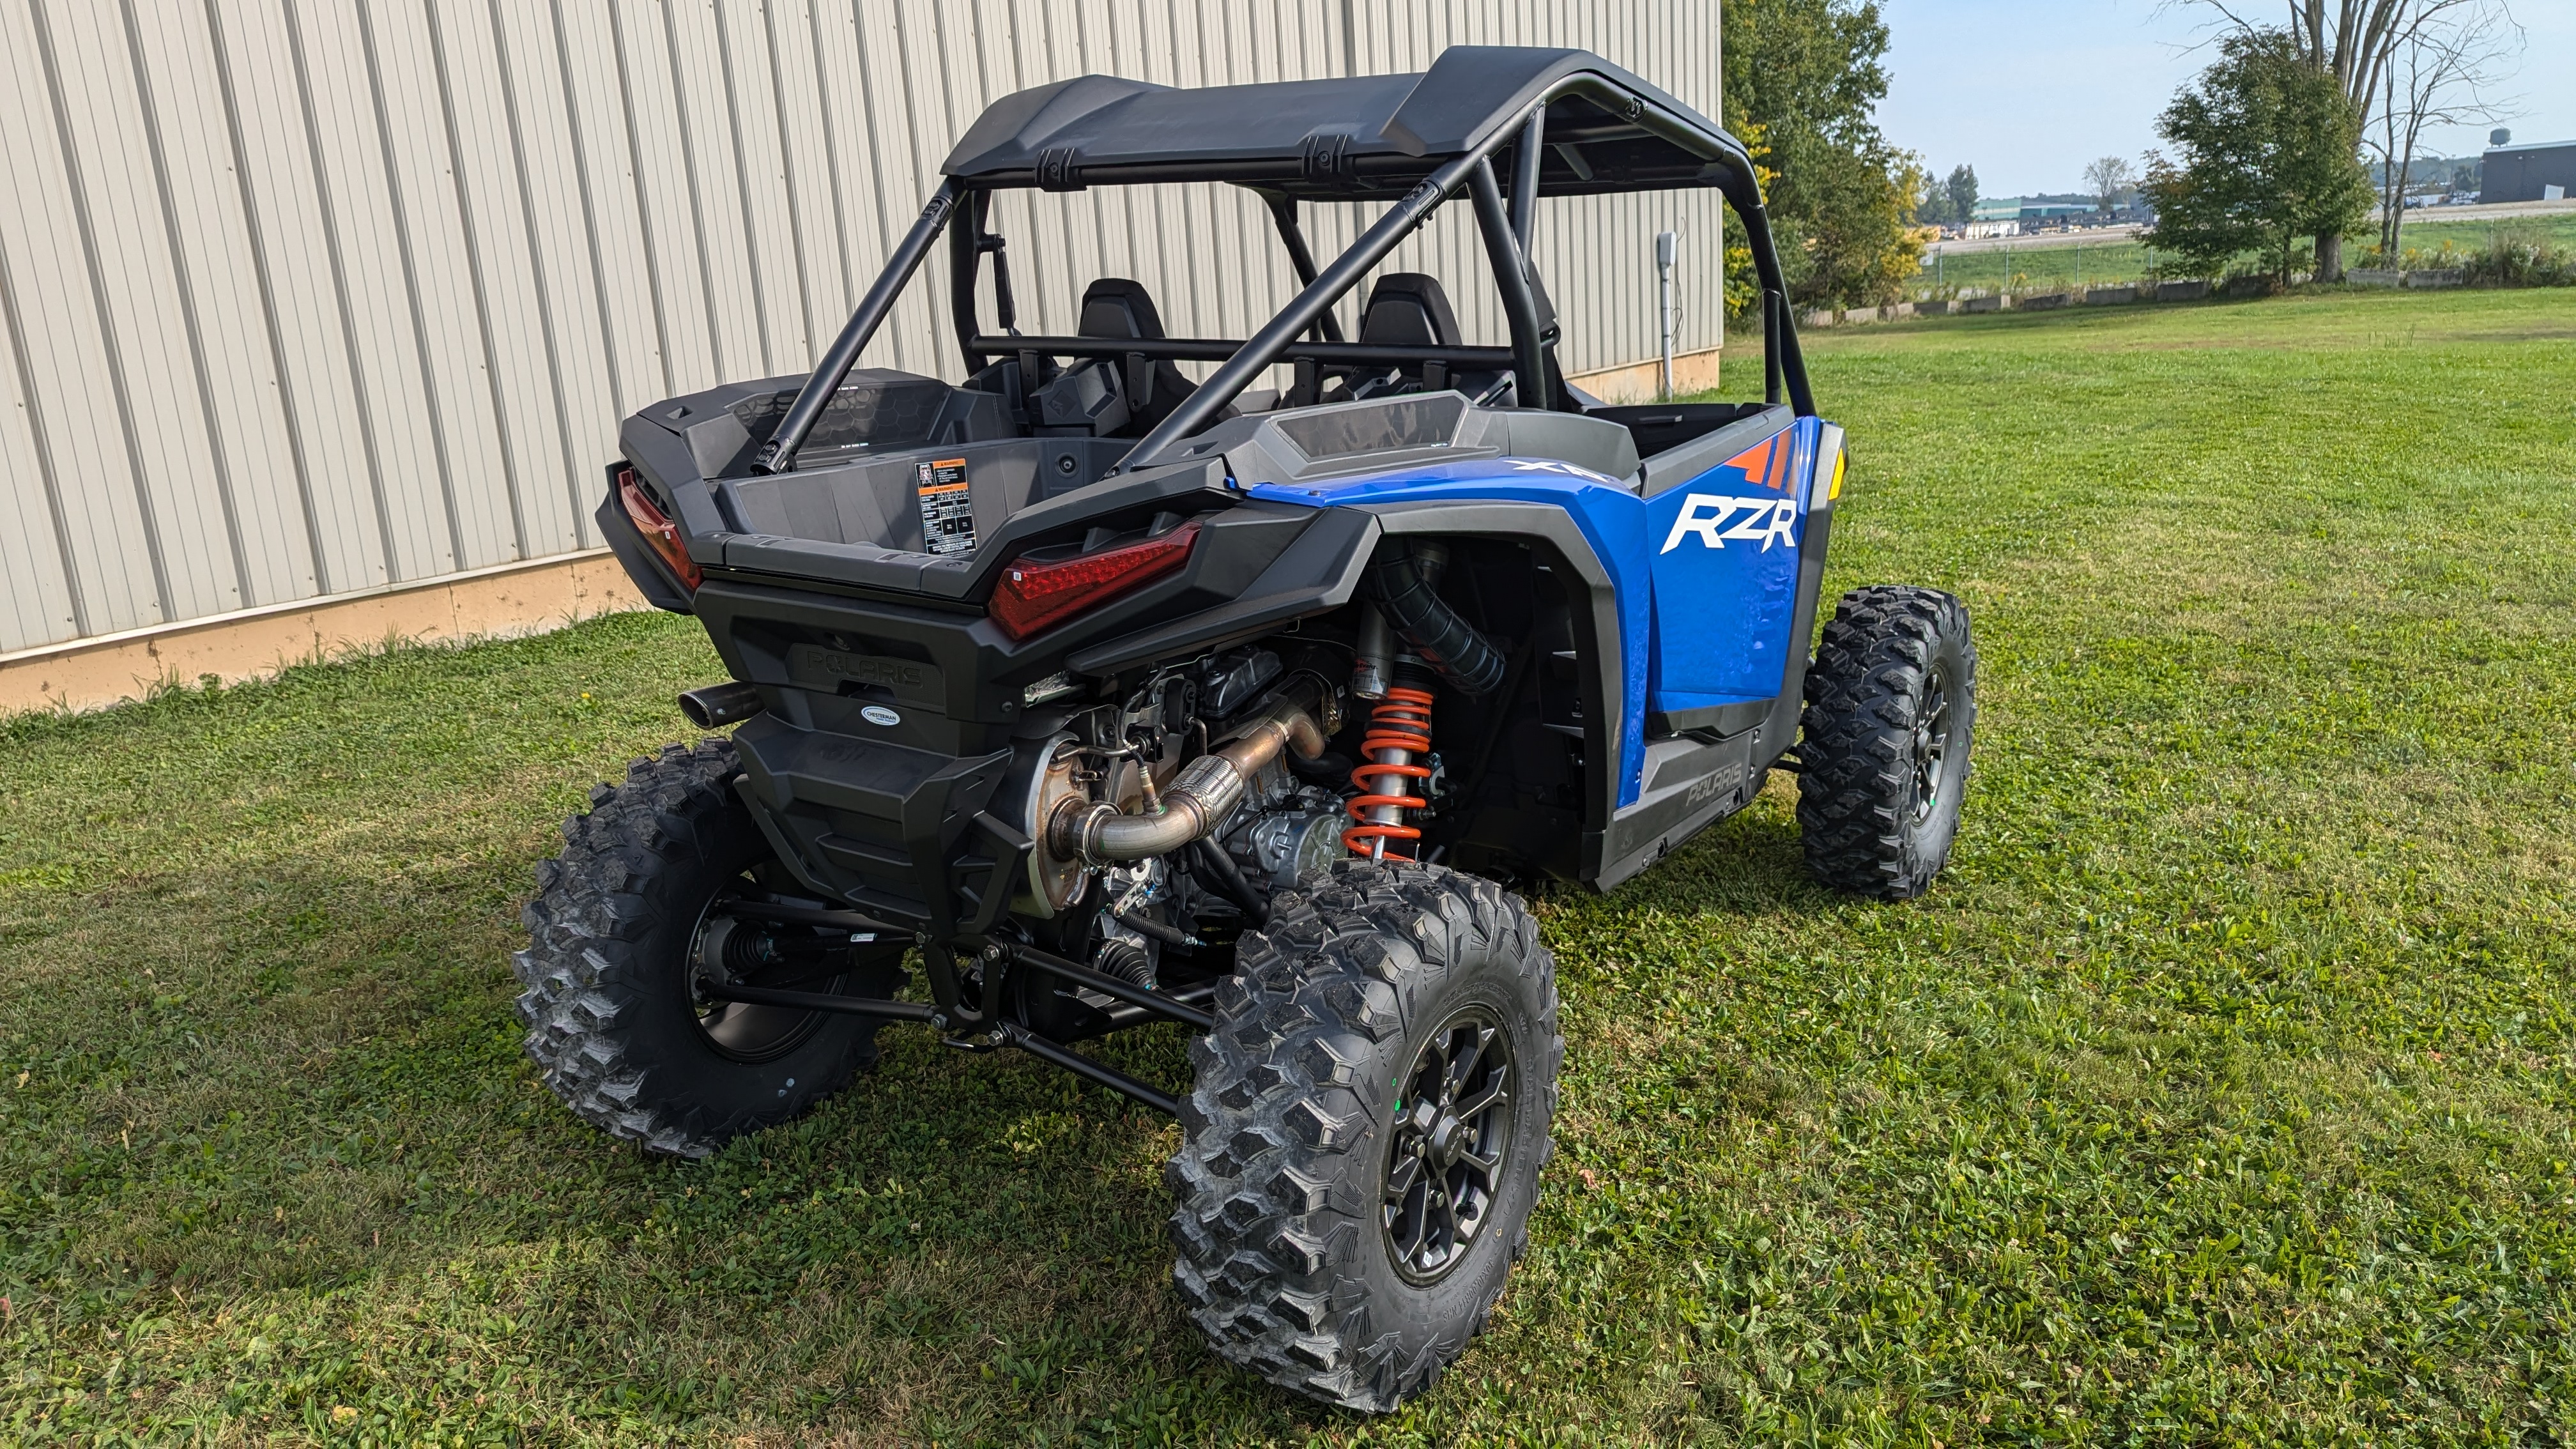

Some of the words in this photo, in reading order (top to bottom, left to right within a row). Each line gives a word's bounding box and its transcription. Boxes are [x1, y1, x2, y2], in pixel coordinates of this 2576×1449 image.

[1659, 493, 1797, 555] RZR
[808, 651, 924, 689] POLARIS
[867, 712, 896, 721] CHESTERMAN
[1686, 762, 1742, 806] POLARIS
